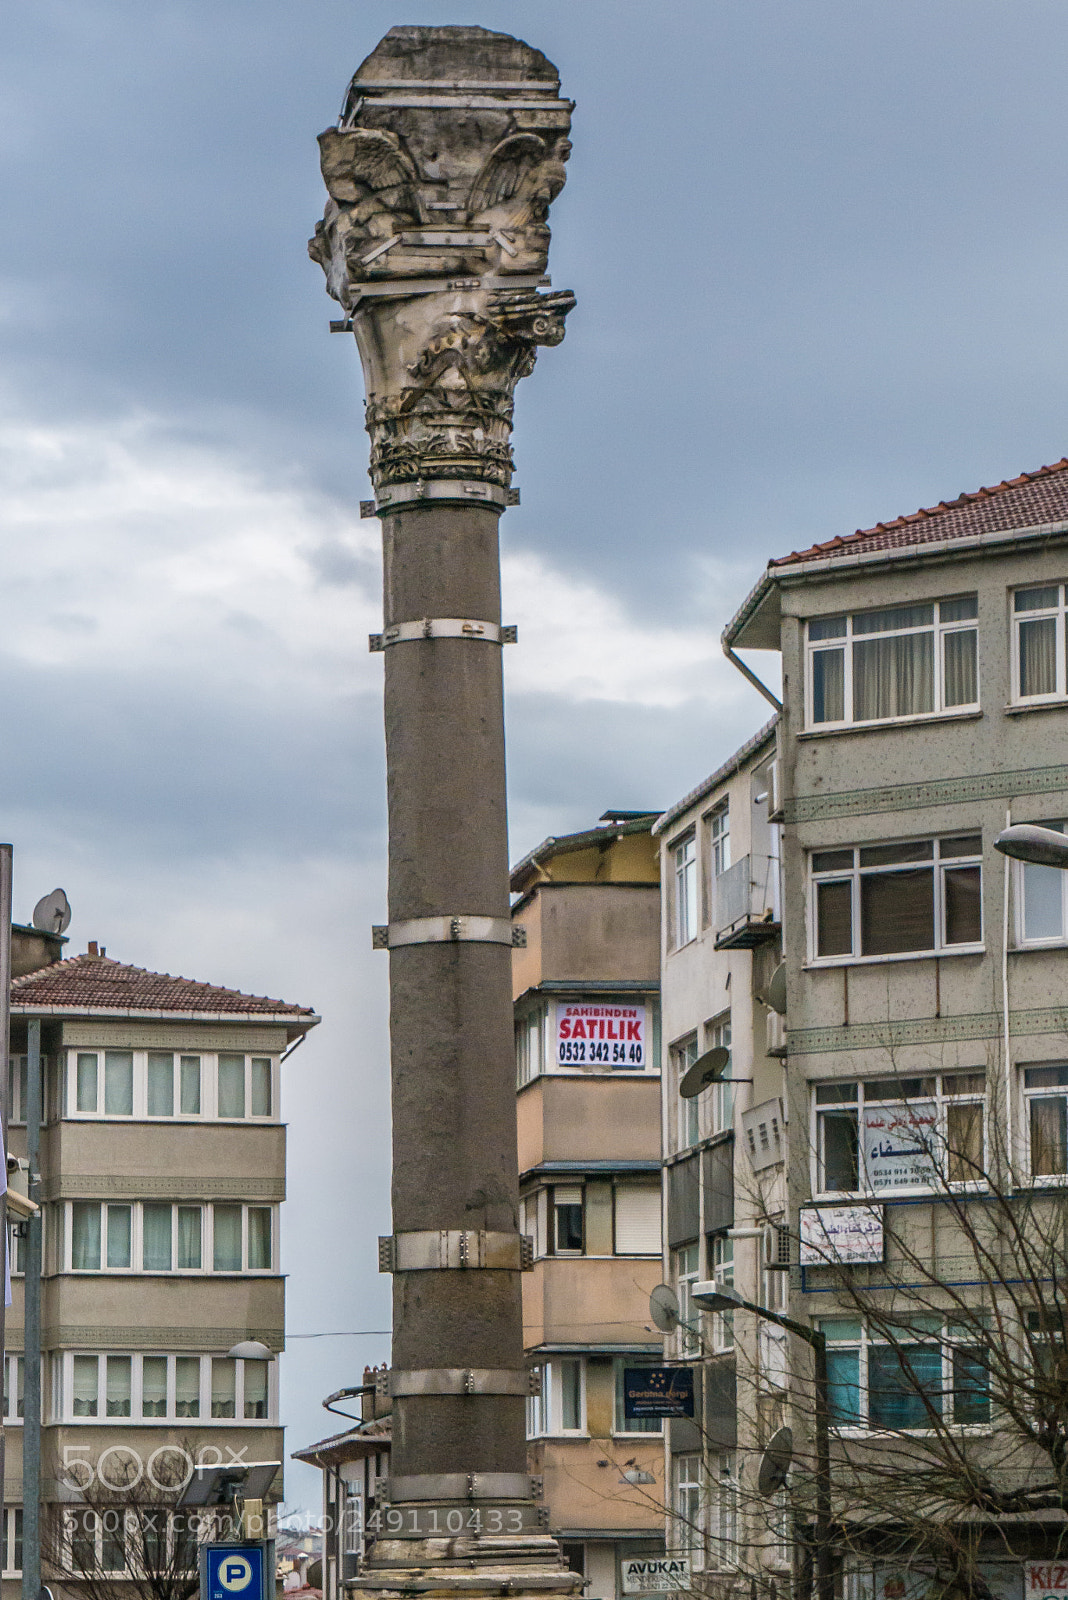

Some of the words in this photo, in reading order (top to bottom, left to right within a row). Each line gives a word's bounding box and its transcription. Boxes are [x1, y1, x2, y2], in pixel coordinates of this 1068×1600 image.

[566, 1007, 637, 1018] SAHİBİNDEN
[559, 1018, 642, 1041] SATILIK
[559, 1042, 586, 1061] 0532
[589, 1042, 609, 1062] 342
[613, 1043, 626, 1063] 54
[629, 1043, 642, 1063] 40
[226, 1564, 246, 1584] P
[628, 1561, 687, 1575] AVUKAT
